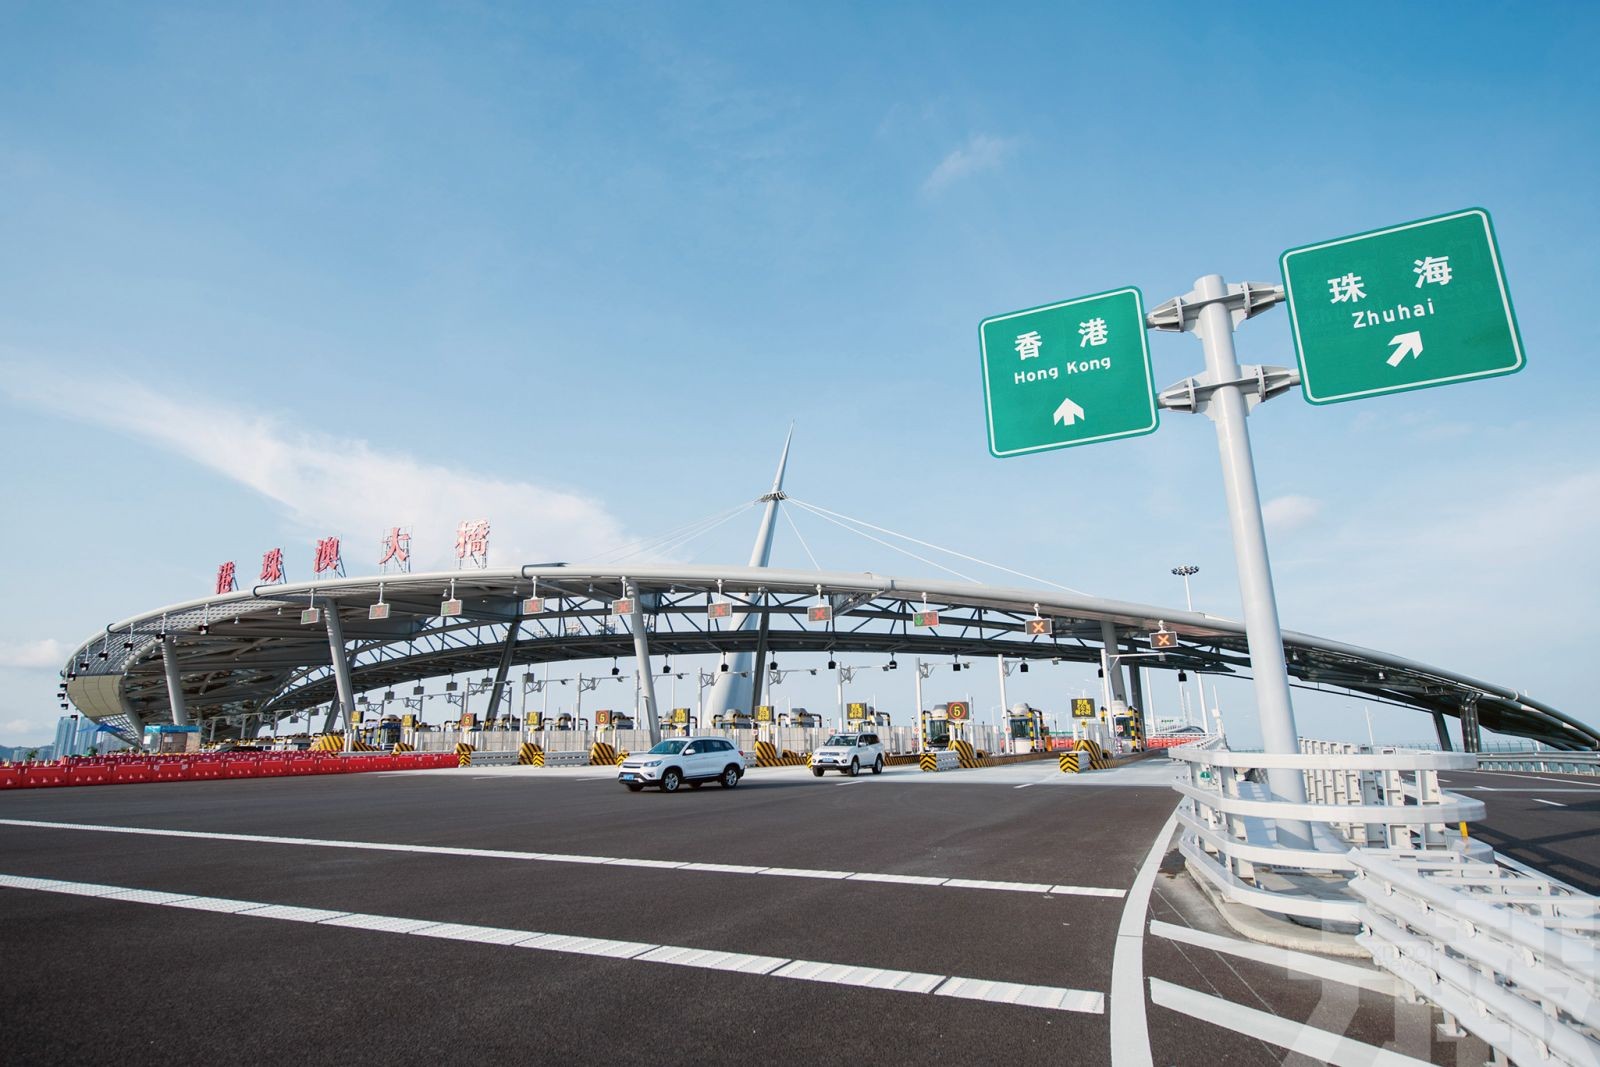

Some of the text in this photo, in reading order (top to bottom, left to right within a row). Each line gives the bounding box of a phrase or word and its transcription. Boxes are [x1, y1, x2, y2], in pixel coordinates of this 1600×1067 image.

[1327, 256, 1453, 304] 珠海
[1351, 298, 1435, 329] Zhuhai
[1014, 317, 1109, 361] 香港
[1014, 357, 1112, 385] Hong Kong
